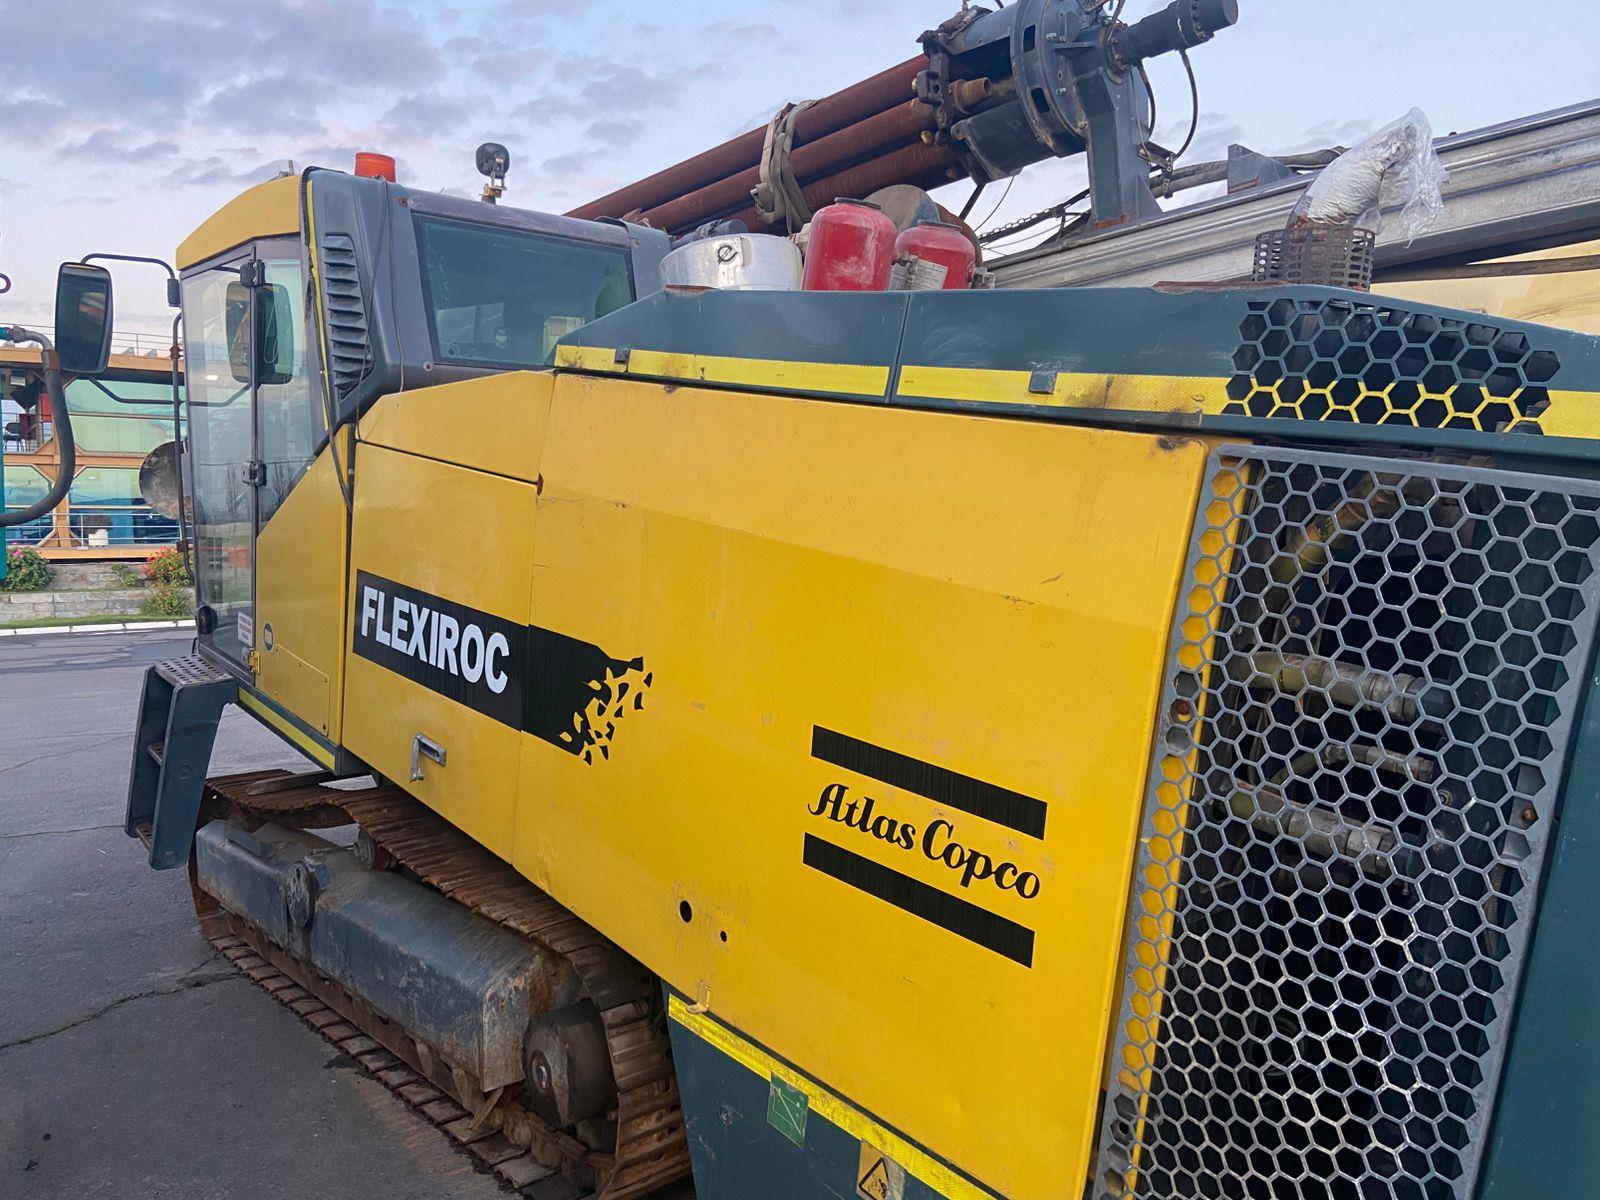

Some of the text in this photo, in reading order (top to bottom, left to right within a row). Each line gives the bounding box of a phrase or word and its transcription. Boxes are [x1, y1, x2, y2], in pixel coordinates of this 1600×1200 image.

[361, 585, 510, 694] FLEXIROC
[807, 783, 1041, 899] Atlas Copco
